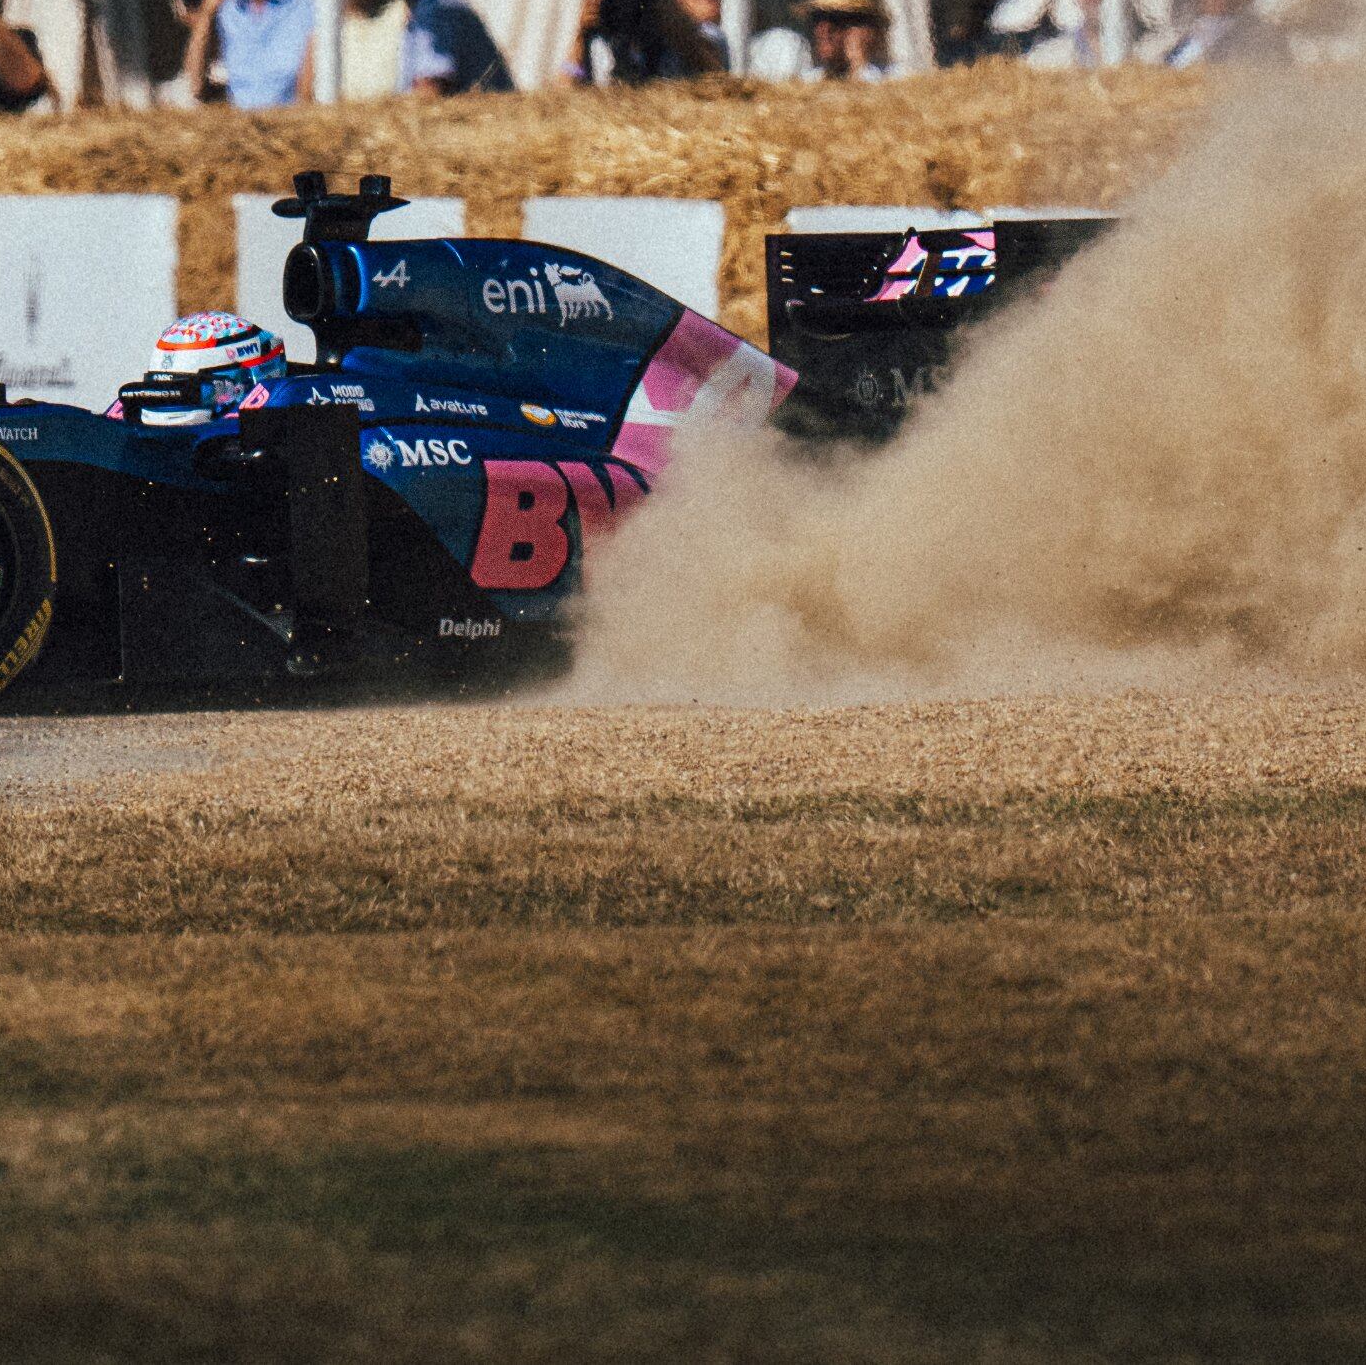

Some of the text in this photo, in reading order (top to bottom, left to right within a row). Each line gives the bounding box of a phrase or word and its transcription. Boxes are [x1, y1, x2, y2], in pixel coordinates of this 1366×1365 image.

[483, 267, 547, 314] eni
[430, 399, 489, 416] avature
[395, 439, 472, 467] MSC
[440, 618, 502, 640] Delphi
